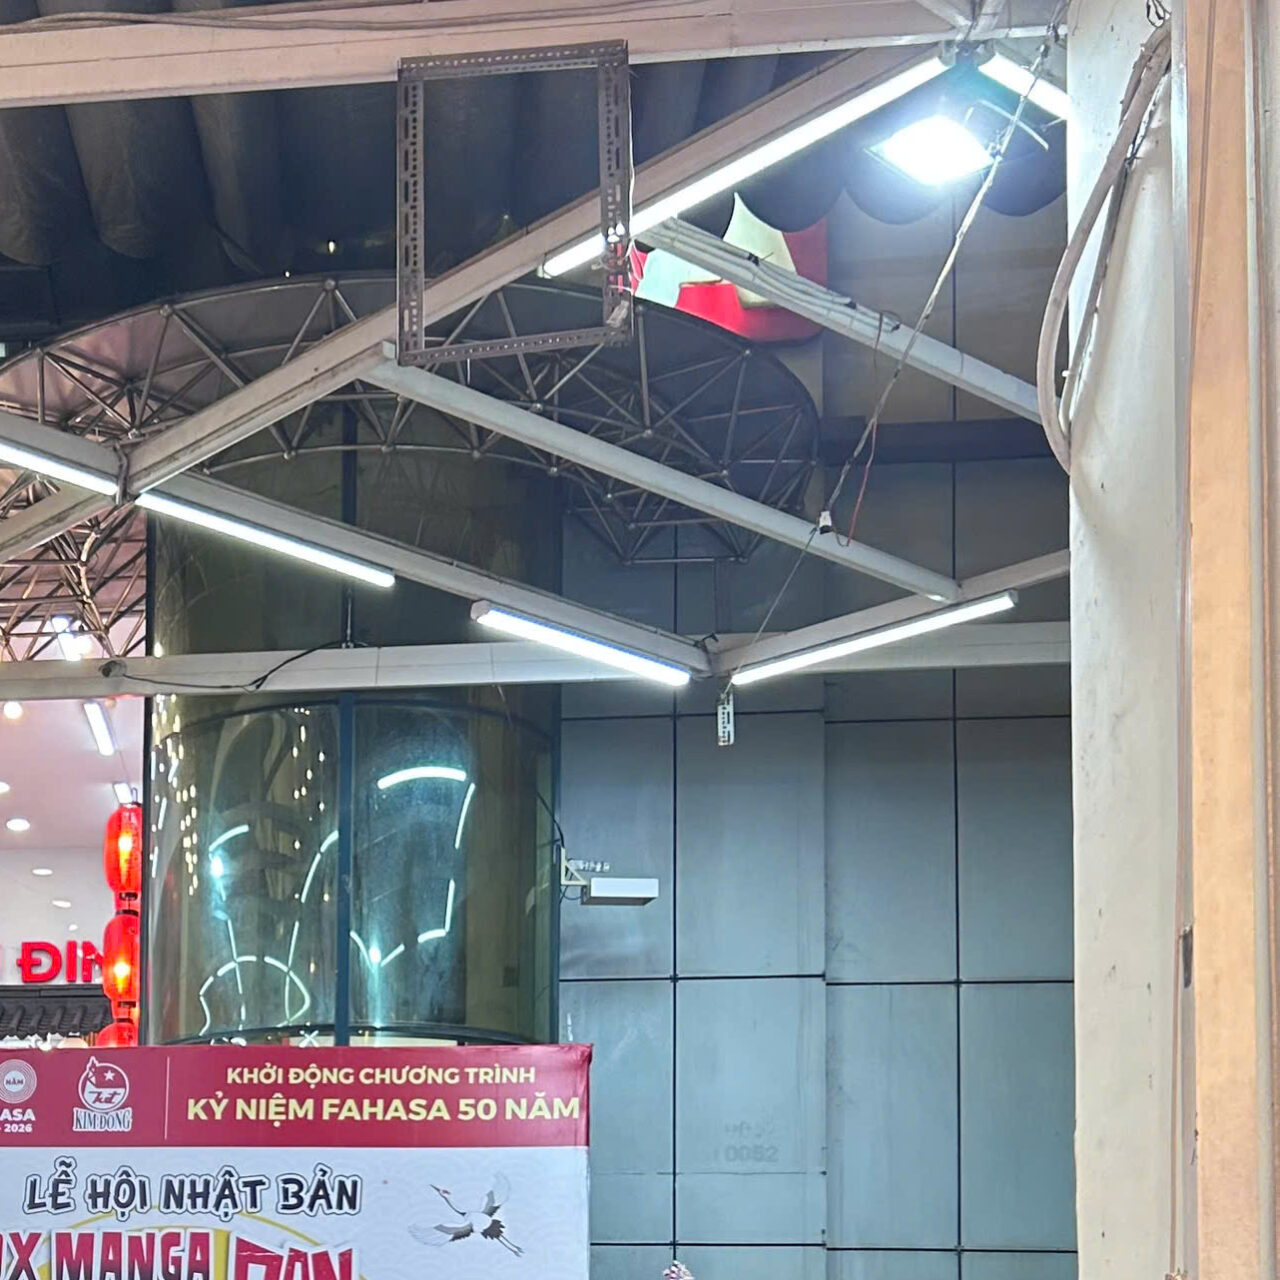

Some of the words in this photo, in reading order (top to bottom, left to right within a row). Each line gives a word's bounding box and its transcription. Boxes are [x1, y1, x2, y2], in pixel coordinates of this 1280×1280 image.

[17, 941, 104, 983] ĐIN
[227, 1062, 283, 1084] KHỞI
[288, 1063, 354, 1089] ĐỘNG
[359, 1065, 460, 1085] CHƯƠNG
[465, 1063, 535, 1085] TRÌNH
[75, 1110, 97, 1130] KIM
[187, 1091, 229, 1121] KỶ
[236, 1092, 314, 1128] NIỆM
[322, 1098, 451, 1121] FAHASA
[457, 1098, 497, 1121] 50
[505, 1091, 580, 1120] NĂM
[4, 1123, 33, 1133] 2026
[26, 1158, 74, 1211] LỄ
[87, 1168, 149, 1219] HỘI
[161, 1168, 268, 1219] NHẬT
[278, 1165, 360, 1214] BẢN
